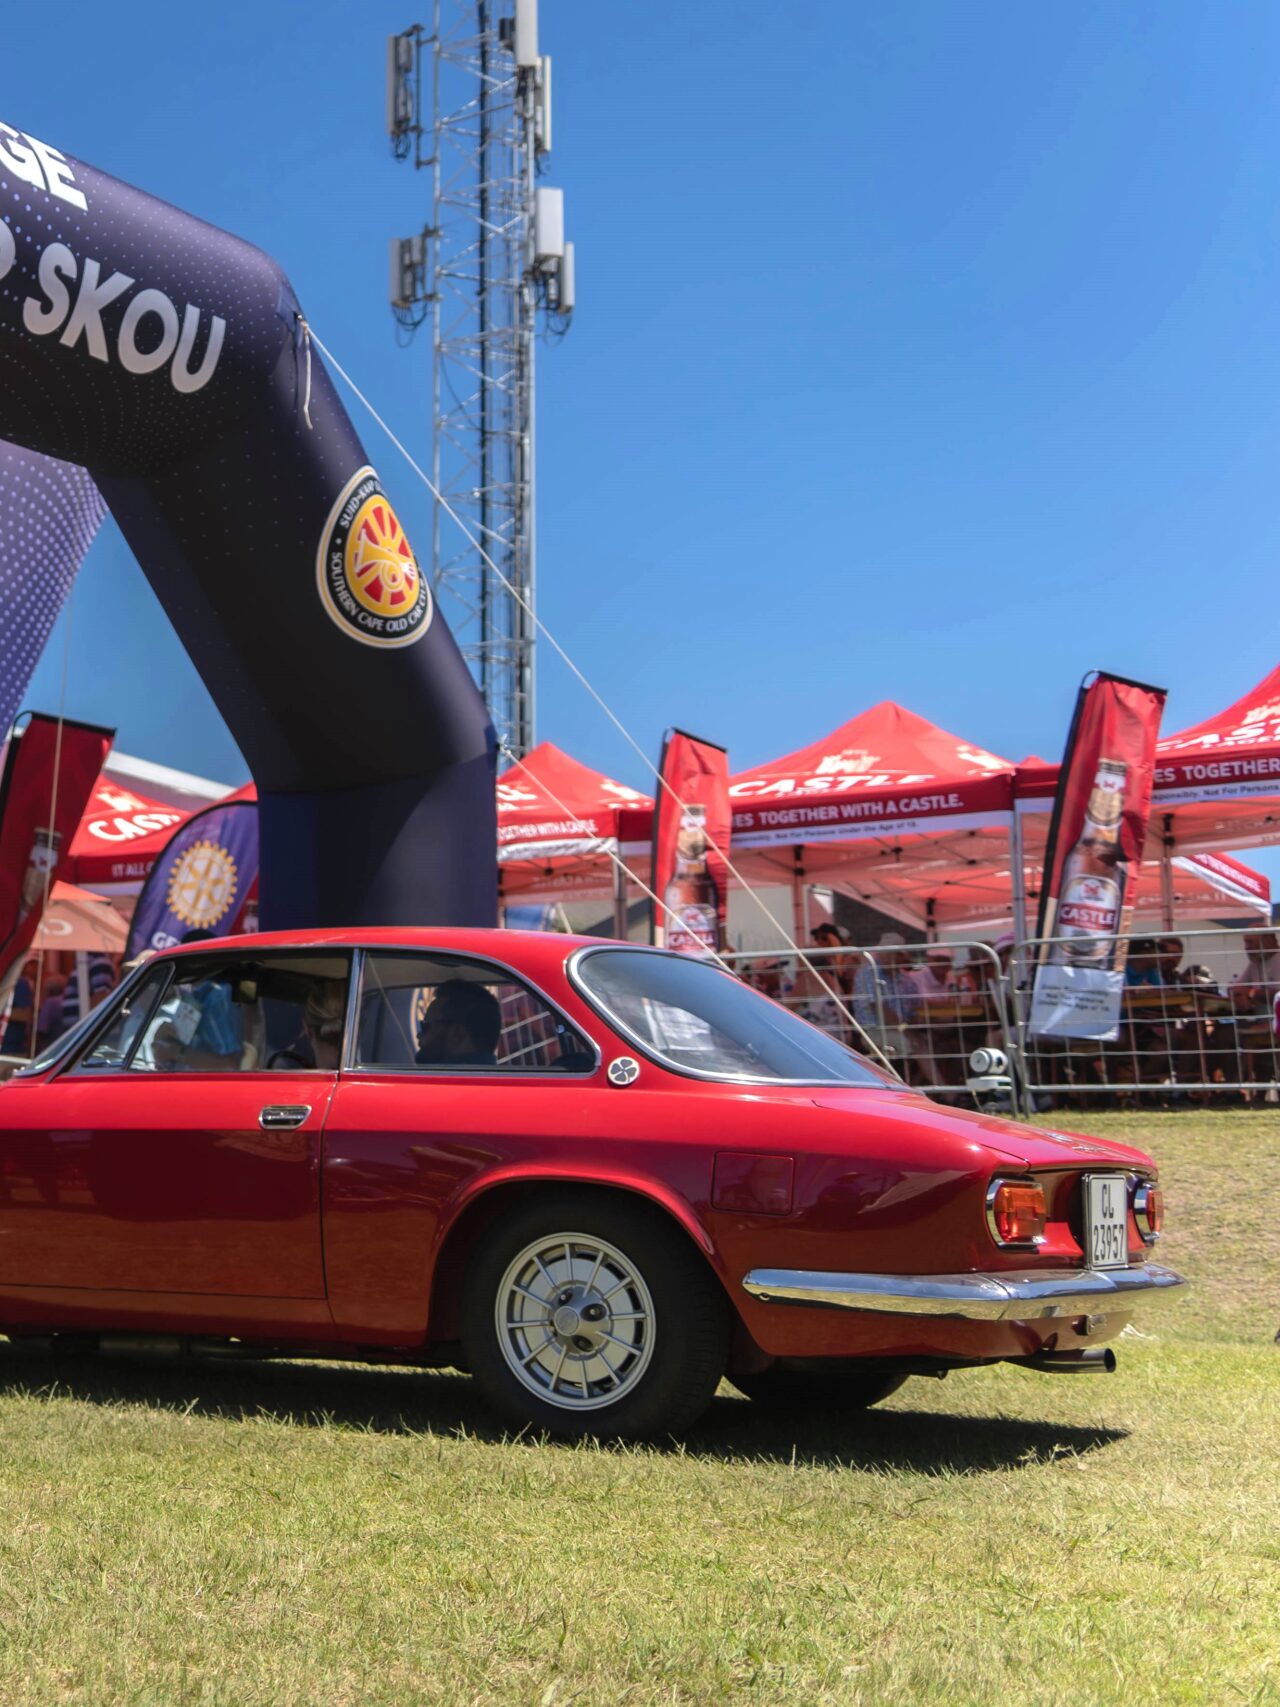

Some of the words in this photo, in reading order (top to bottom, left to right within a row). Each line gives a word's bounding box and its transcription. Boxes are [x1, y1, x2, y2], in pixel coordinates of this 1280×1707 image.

[22, 241, 227, 394] SKOU
[330, 552, 360, 617] SOUTHERN
[357, 611, 385, 632] CAPE
[385, 618, 409, 633] OLD
[728, 773, 936, 798] CASTLE
[1181, 757, 1280, 781] TOGETHER
[758, 804, 840, 826] TOGETHER
[841, 801, 884, 818] WITH
[885, 800, 898, 814] A
[899, 793, 965, 813] CASTLE.
[1060, 906, 1115, 925] CASTLE
[1101, 1183, 1115, 1219] CL
[1093, 1223, 1125, 1262] 23957
